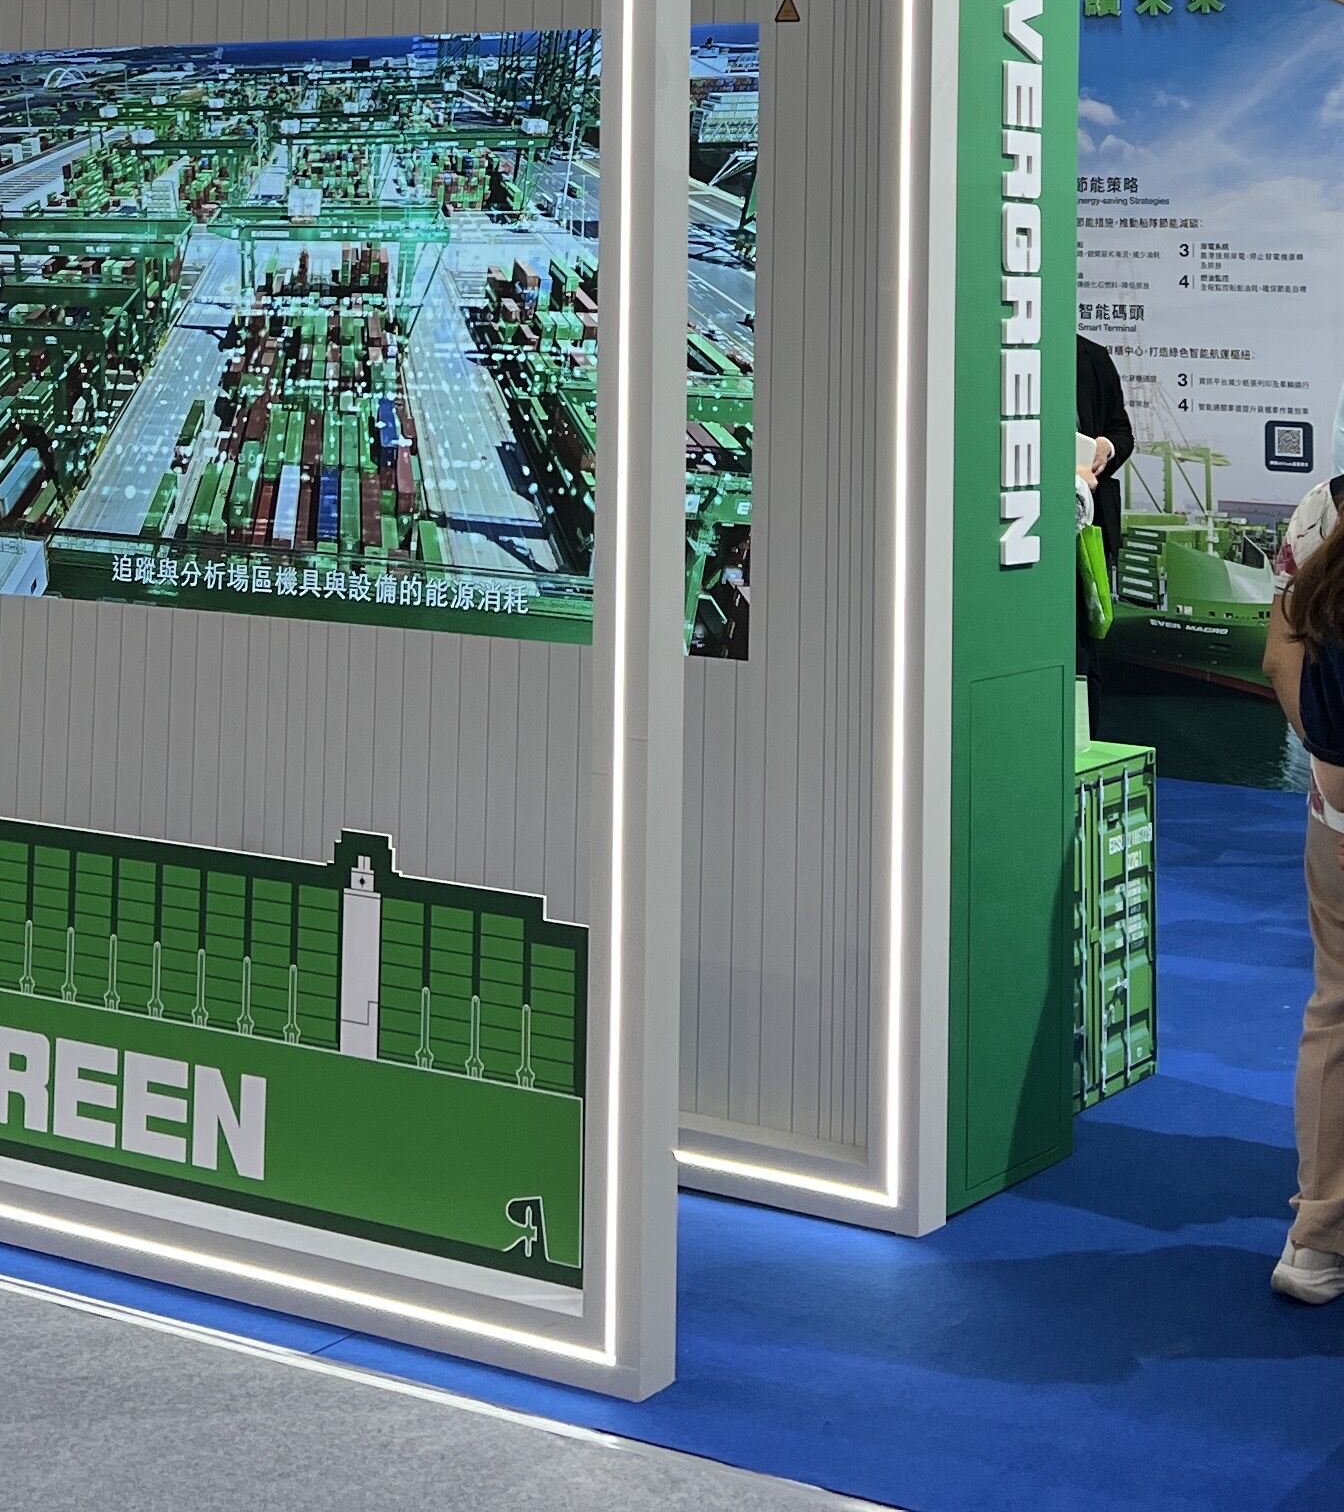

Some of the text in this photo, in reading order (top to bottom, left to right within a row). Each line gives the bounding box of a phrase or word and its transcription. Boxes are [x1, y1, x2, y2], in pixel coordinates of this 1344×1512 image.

[1077, 177, 1138, 193] 節能策略
[1130, 196, 1170, 206] Strategies
[1178, 243, 1190, 257] 3
[1178, 275, 1190, 288] 4
[1078, 303, 1145, 321] 智能碼頭
[1078, 323, 1137, 332] Smart Terminal
[1177, 373, 1188, 387] 3
[1177, 398, 1189, 412] 4
[111, 554, 529, 616] 追蹤與分析場區機具與設備的能源消耗
[1149, 618, 1229, 635] EVER MACRO
